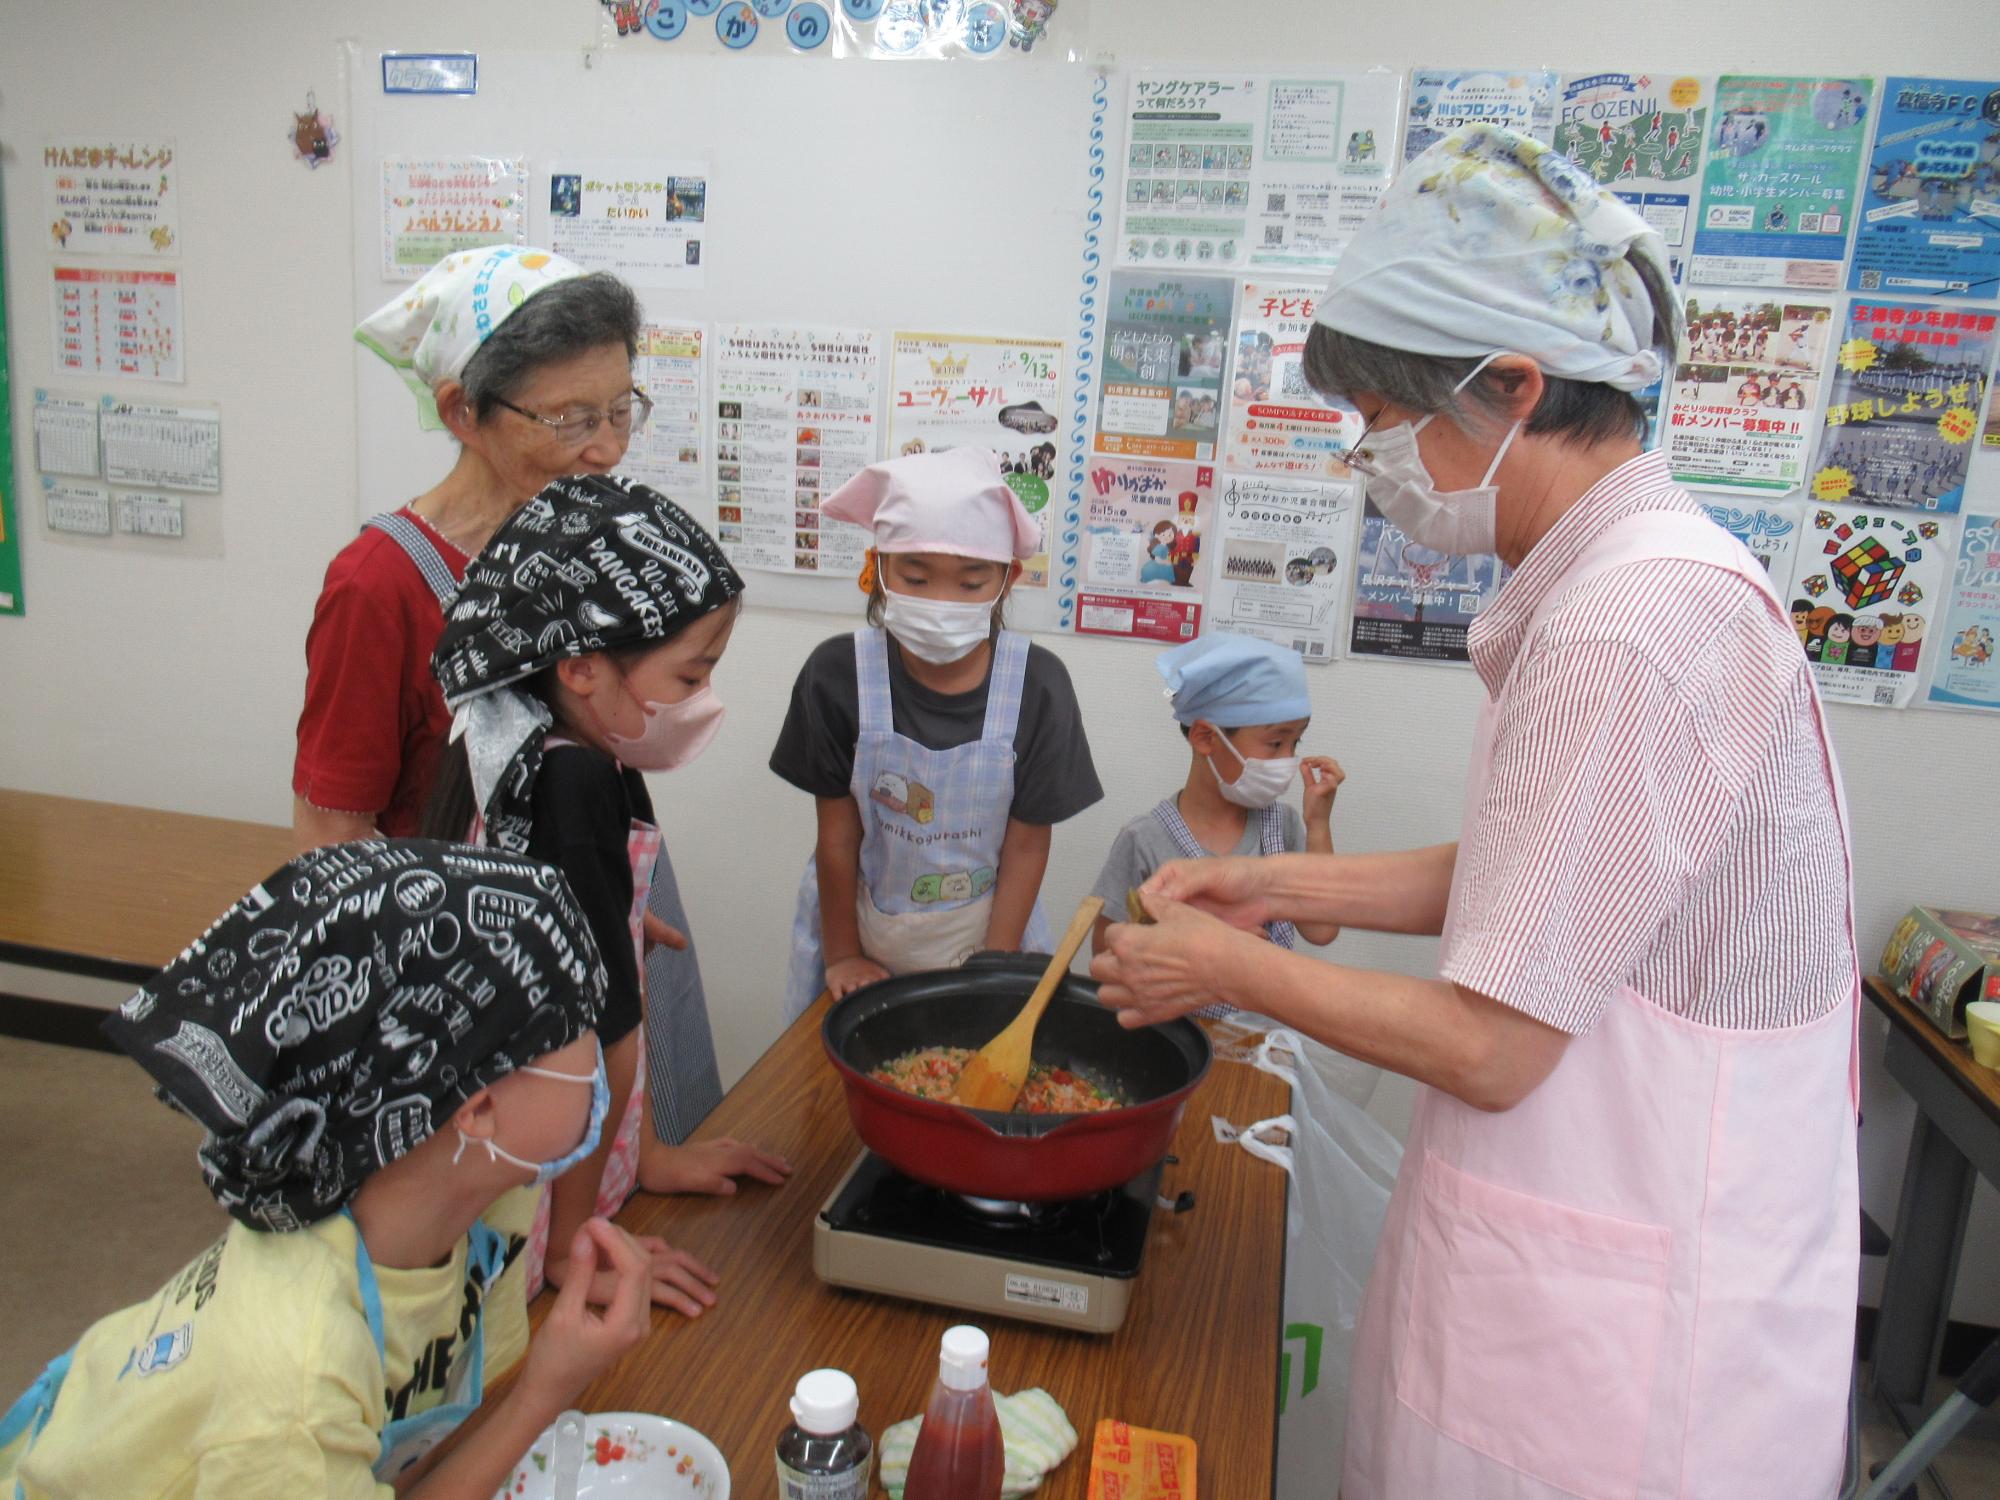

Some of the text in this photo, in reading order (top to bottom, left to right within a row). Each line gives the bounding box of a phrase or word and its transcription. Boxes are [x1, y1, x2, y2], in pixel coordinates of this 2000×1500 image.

[656, 7, 818, 37] こ か の
[1137, 80, 1235, 96] ヤングケアラー
[1136, 97, 1206, 109] って何だろう？
[1562, 98, 1657, 124] FC OZENJI
[44, 145, 173, 170] けんだまチャレンジ
[1737, 172, 1823, 185] サッカースクール
[608, 207, 650, 219] たいかい
[1673, 403, 1759, 417] みどり少年野球クラブ
[1091, 466, 1167, 495] ゆりがおか
[1130, 494, 1172, 507] 児童合唱団
[1242, 492, 1338, 509] ゆりがおか児童合唱団
[1701, 503, 1795, 537] ミントン
[1383, 528, 1413, 543] バス
[632, 528, 706, 582] BREAKFAST
[585, 536, 665, 640] PANCAKES
[397, 876, 441, 911] with
